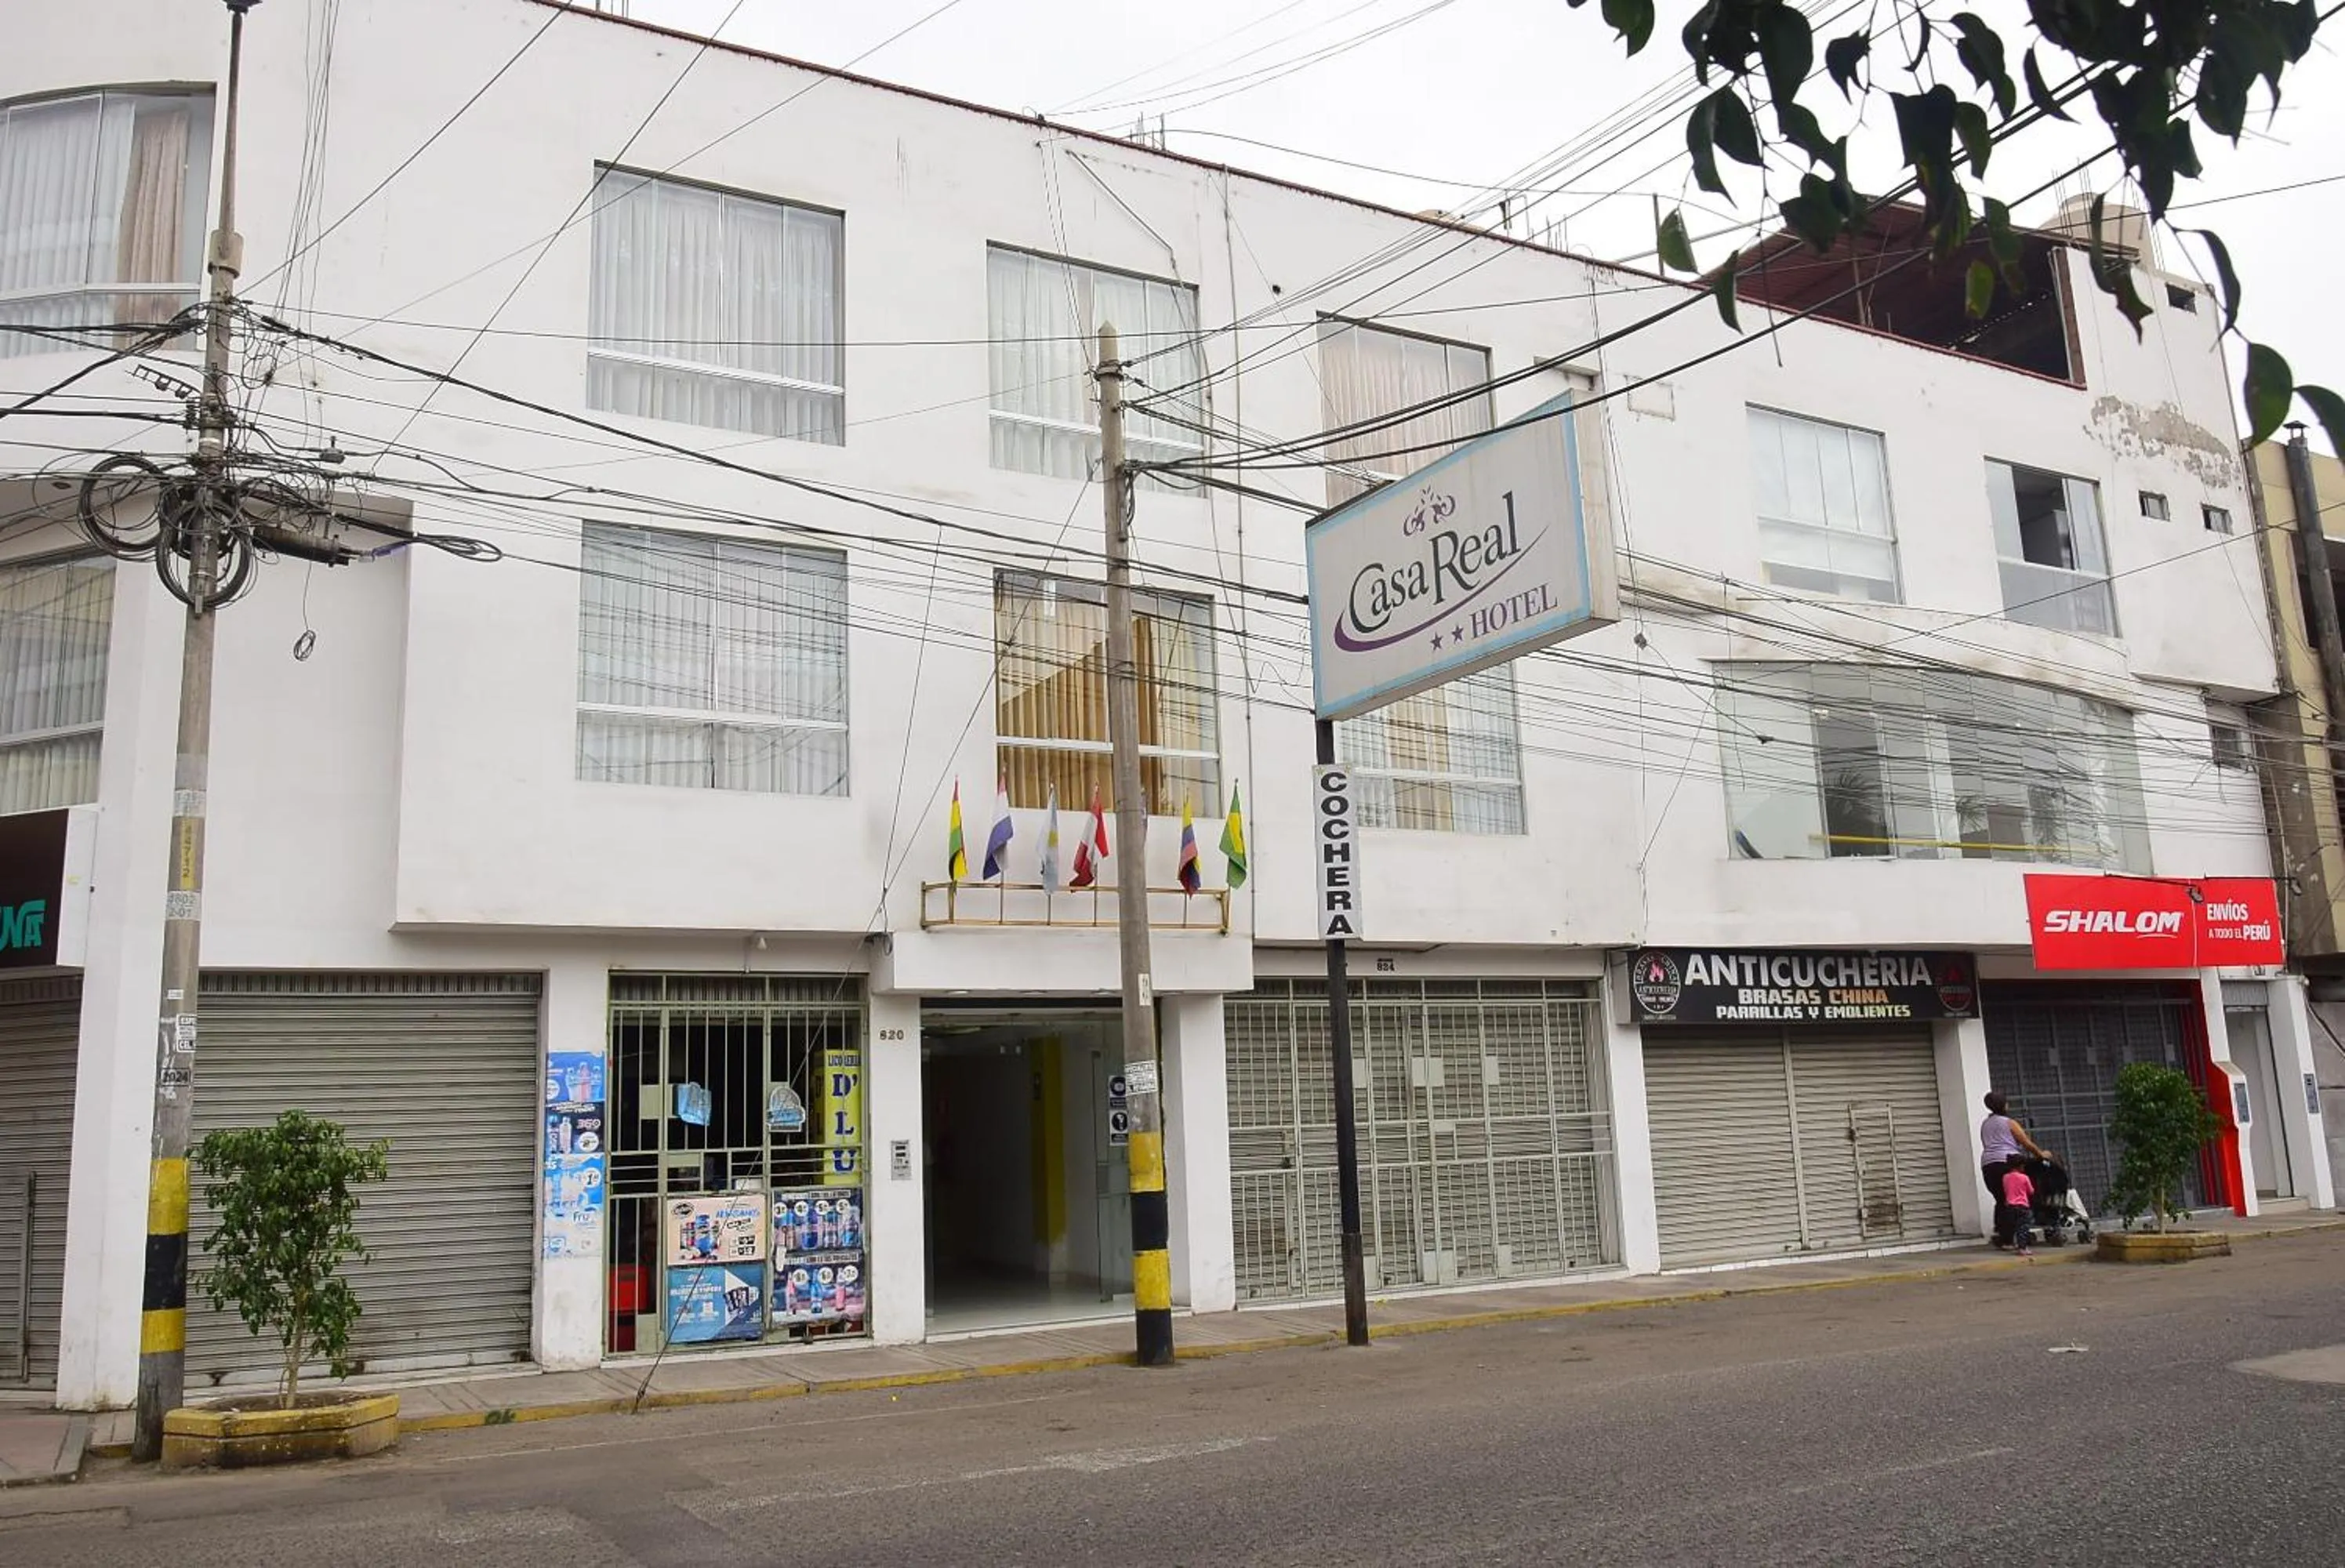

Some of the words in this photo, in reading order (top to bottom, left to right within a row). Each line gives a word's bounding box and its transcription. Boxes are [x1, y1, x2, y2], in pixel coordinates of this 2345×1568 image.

[1349, 562, 1429, 633] Casa
[1428, 489, 1522, 605] Real
[1469, 583, 1558, 639] HOTEL
[1320, 771, 1353, 935] COCHERA
[2206, 898, 2249, 921] ENVÍOS
[2044, 910, 2182, 934] SHALOM
[2209, 928, 2214, 938] A
[2214, 928, 2233, 938] TODO
[2243, 919, 2271, 940] PERÚ
[1377, 962, 1395, 971] 824
[1684, 953, 1933, 987] ANTICUCHERIA
[1738, 988, 1822, 1004] BRASAS
[1828, 988, 1889, 1004] CHINA
[1716, 1006, 1802, 1019] PARRILLAS
[1808, 1005, 1820, 1018] Y
[1824, 1005, 1911, 1018] EMOLIENTES
[162, 1072, 189, 1083] 2024
